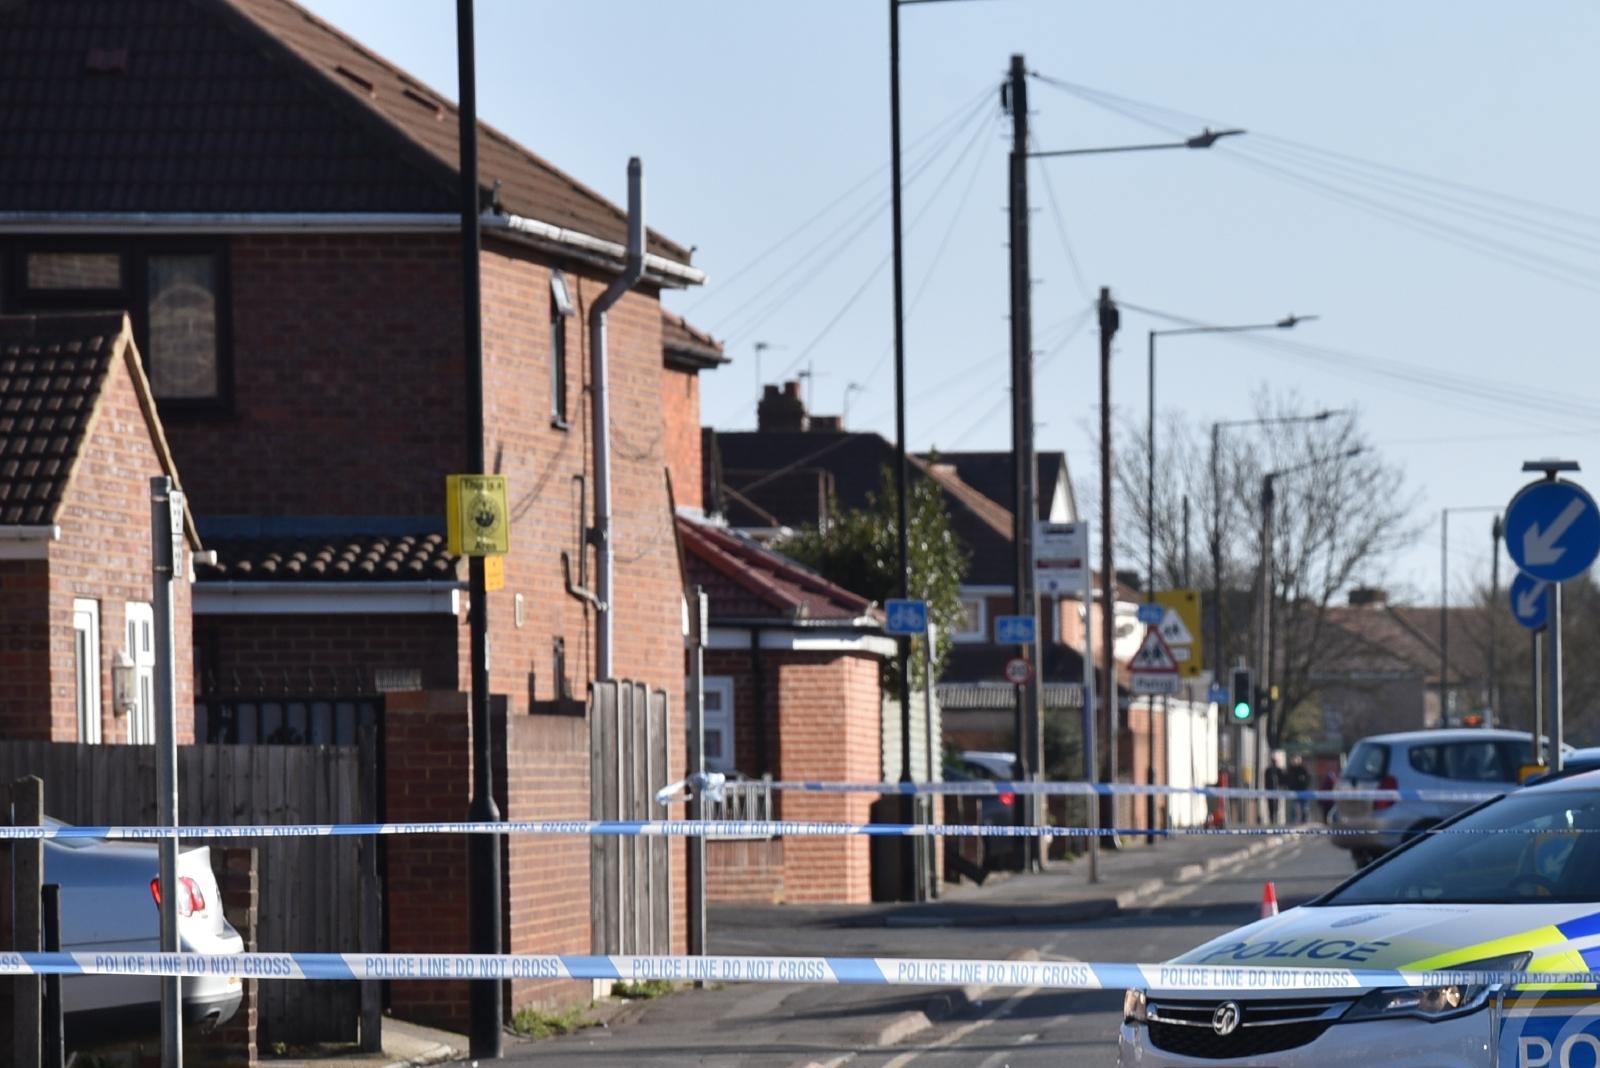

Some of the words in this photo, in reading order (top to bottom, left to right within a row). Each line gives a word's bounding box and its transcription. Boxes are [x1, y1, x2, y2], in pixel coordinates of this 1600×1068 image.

[1202, 938, 1391, 962] POLICE
[95, 956, 145, 973] POLICE
[150, 957, 181, 973] LINE
[187, 957, 206, 973] DO
[211, 957, 238, 974] NOT
[243, 957, 292, 975] CROSS
[366, 957, 414, 976] POLICE
[420, 958, 450, 977] LINE
[456, 958, 474, 977] DO
[479, 958, 507, 977] NOT
[512, 958, 559, 977] CROSS
[632, 959, 682, 978] POLICE
[686, 959, 717, 979] LINE
[722, 960, 741, 979] DO
[746, 960, 774, 980] NOT
[778, 960, 825, 980] CROSS
[898, 962, 946, 981] POLICE
[951, 963, 982, 983] LINE
[986, 964, 1006, 983] DO
[1010, 964, 1036, 984] NOT
[1043, 966, 1088, 984] CROSS
[1160, 968, 1209, 986] POLICE
[1213, 968, 1243, 986] LINE
[1248, 969, 1267, 986] DO
[1272, 969, 1297, 987] NOT
[1303, 971, 1350, 987] CROSS
[1422, 972, 1470, 985] POLICE
[1474, 972, 1504, 985] LINE
[1510, 973, 1529, 985] DO
[1533, 973, 1560, 984] NOT
